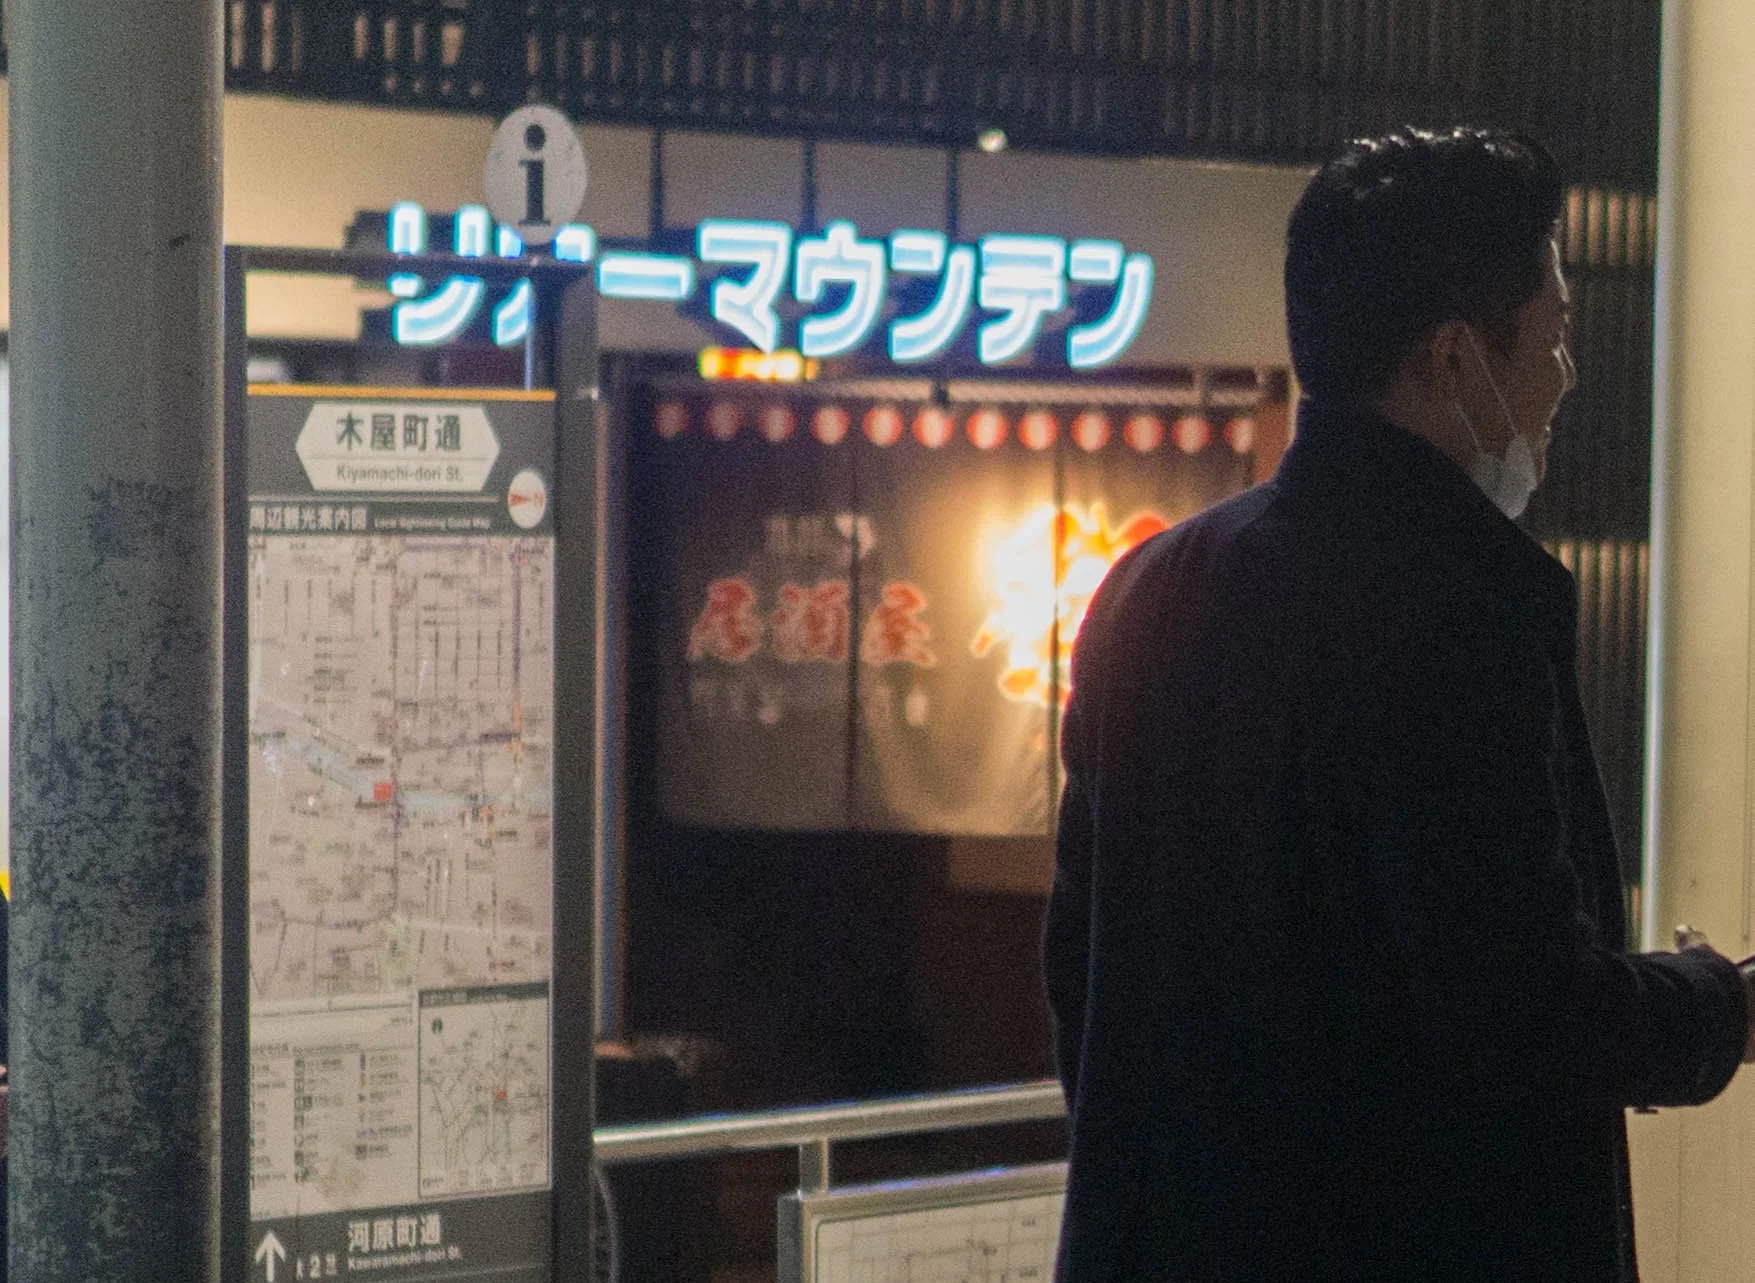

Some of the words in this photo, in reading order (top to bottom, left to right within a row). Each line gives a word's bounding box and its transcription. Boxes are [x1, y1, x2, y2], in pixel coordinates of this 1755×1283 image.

[337, 412, 461, 452] 木屋町通
[336, 465, 441, 484] Kiyamachi-dori
[347, 1214, 441, 1253] 河原町通
